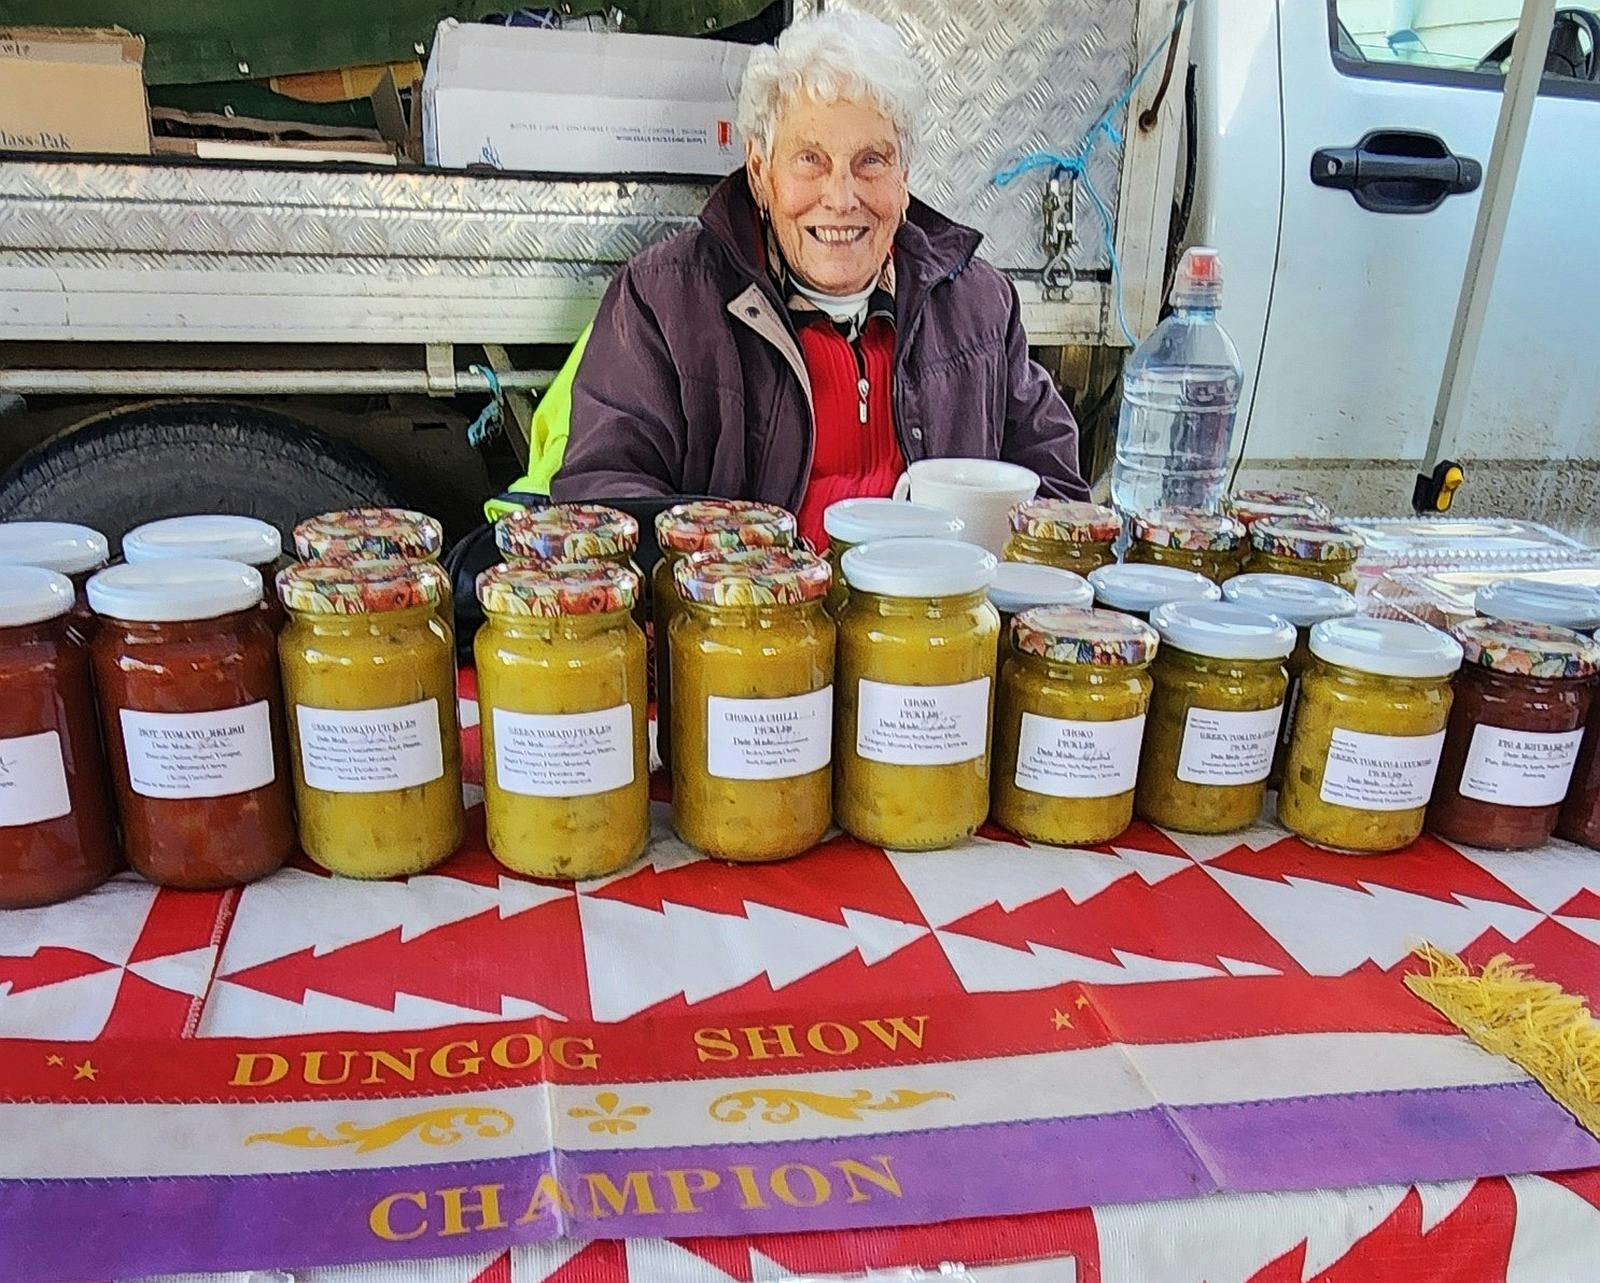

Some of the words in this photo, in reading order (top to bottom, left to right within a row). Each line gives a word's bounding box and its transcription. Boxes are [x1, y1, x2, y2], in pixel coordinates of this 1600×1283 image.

[0, 130, 71, 149] lass-Pak
[228, 1033, 601, 1087] DUNGOG
[693, 1015, 930, 1063] SHOW
[368, 1155, 906, 1242] CHAMPION
